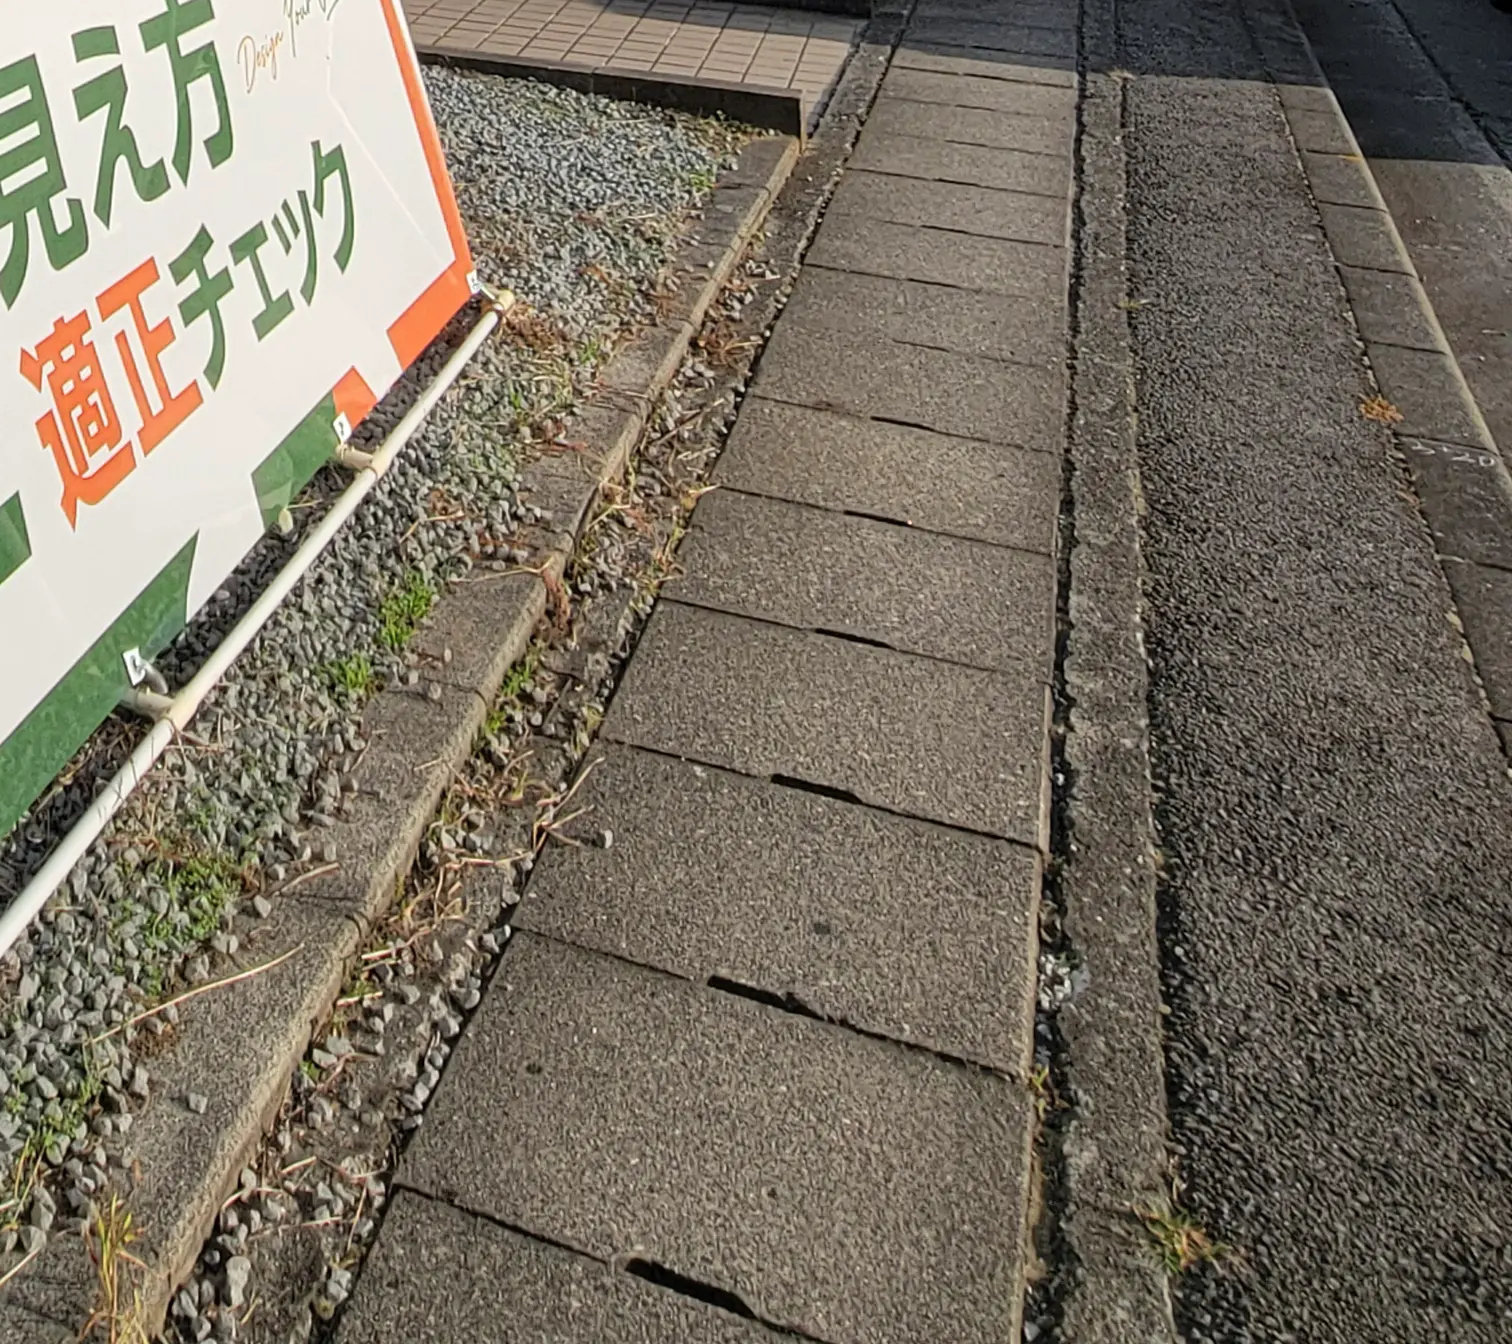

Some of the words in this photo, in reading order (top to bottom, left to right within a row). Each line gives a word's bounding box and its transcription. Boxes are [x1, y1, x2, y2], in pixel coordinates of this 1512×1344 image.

[237, 31, 284, 94] Design
[19, 140, 355, 532] 適正チェック
